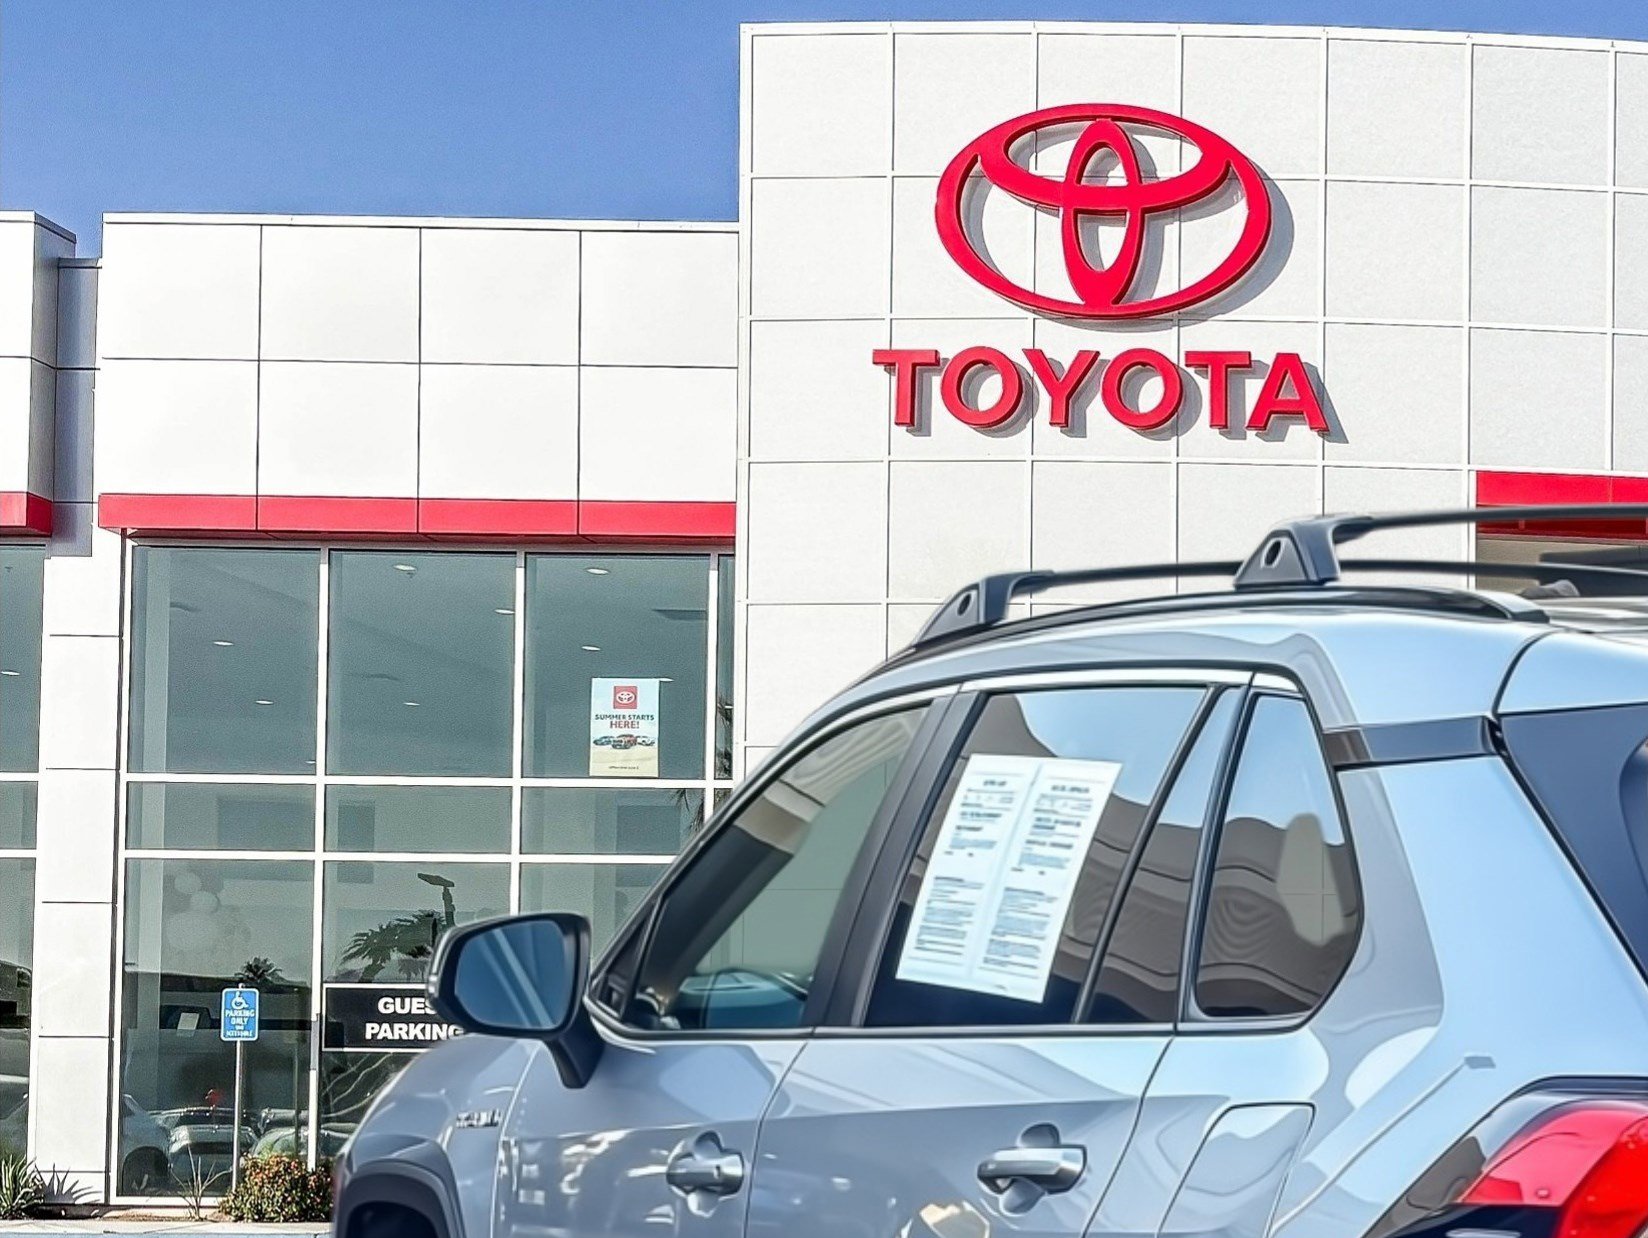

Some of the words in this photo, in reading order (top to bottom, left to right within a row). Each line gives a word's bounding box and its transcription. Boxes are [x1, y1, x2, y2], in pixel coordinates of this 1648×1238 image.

[872, 346, 1332, 434] TOYOTA
[609, 721, 640, 729] HERE!
[377, 996, 438, 1015] GUES
